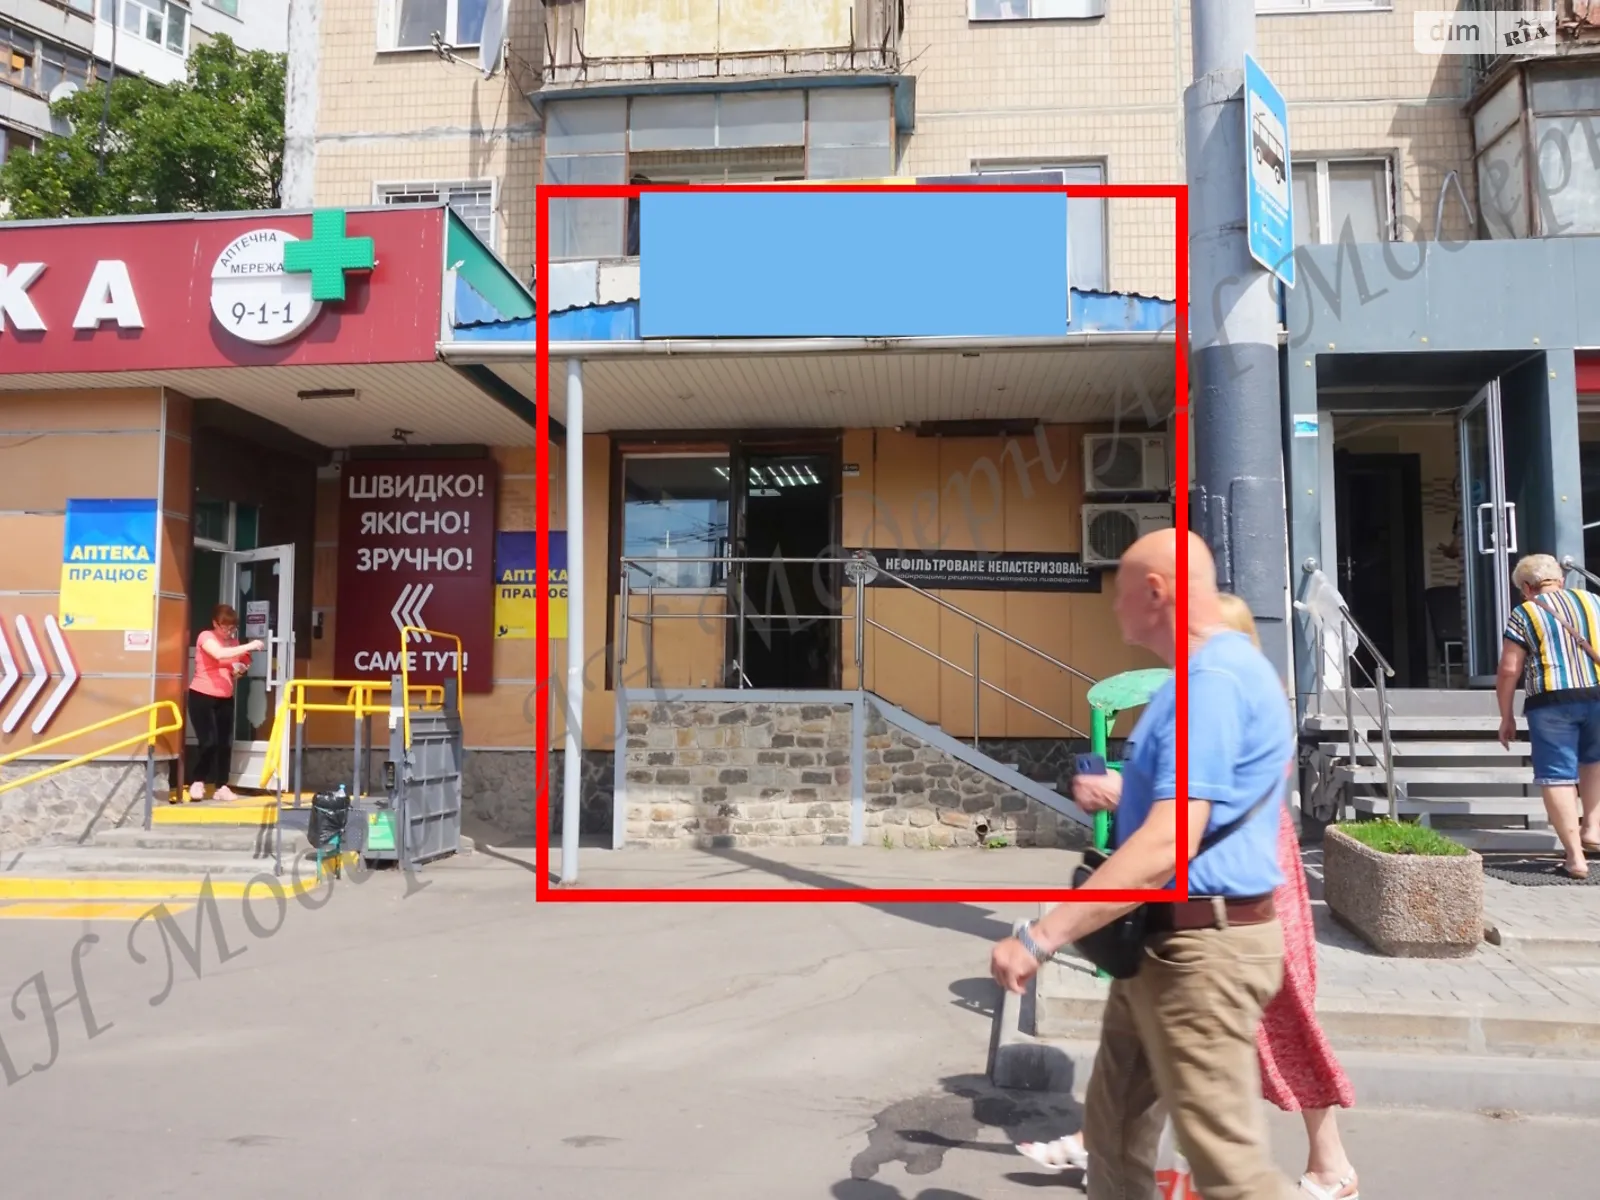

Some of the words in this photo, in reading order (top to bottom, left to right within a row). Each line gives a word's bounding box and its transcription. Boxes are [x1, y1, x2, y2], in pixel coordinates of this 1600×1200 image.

[220, 232, 277, 267] АПТЕЧНА
[230, 263, 284, 274] МЕРЕЖА
[231, 302, 293, 325] 9-1-1
[349, 474, 484, 502] ШВИДКО!
[360, 511, 470, 534] ЯКІСНО!
[70, 545, 150, 561] АПТЕКА
[356, 547, 472, 571] ЗРУЧНО!
[69, 568, 149, 583] ПРАЦЮЄ
[502, 569, 568, 581] АПТКА
[885, 558, 985, 572] НЕФІЛЬТРОВАНЕ
[354, 651, 417, 671] САМЕ
[422, 650, 469, 671] ТУТ!
